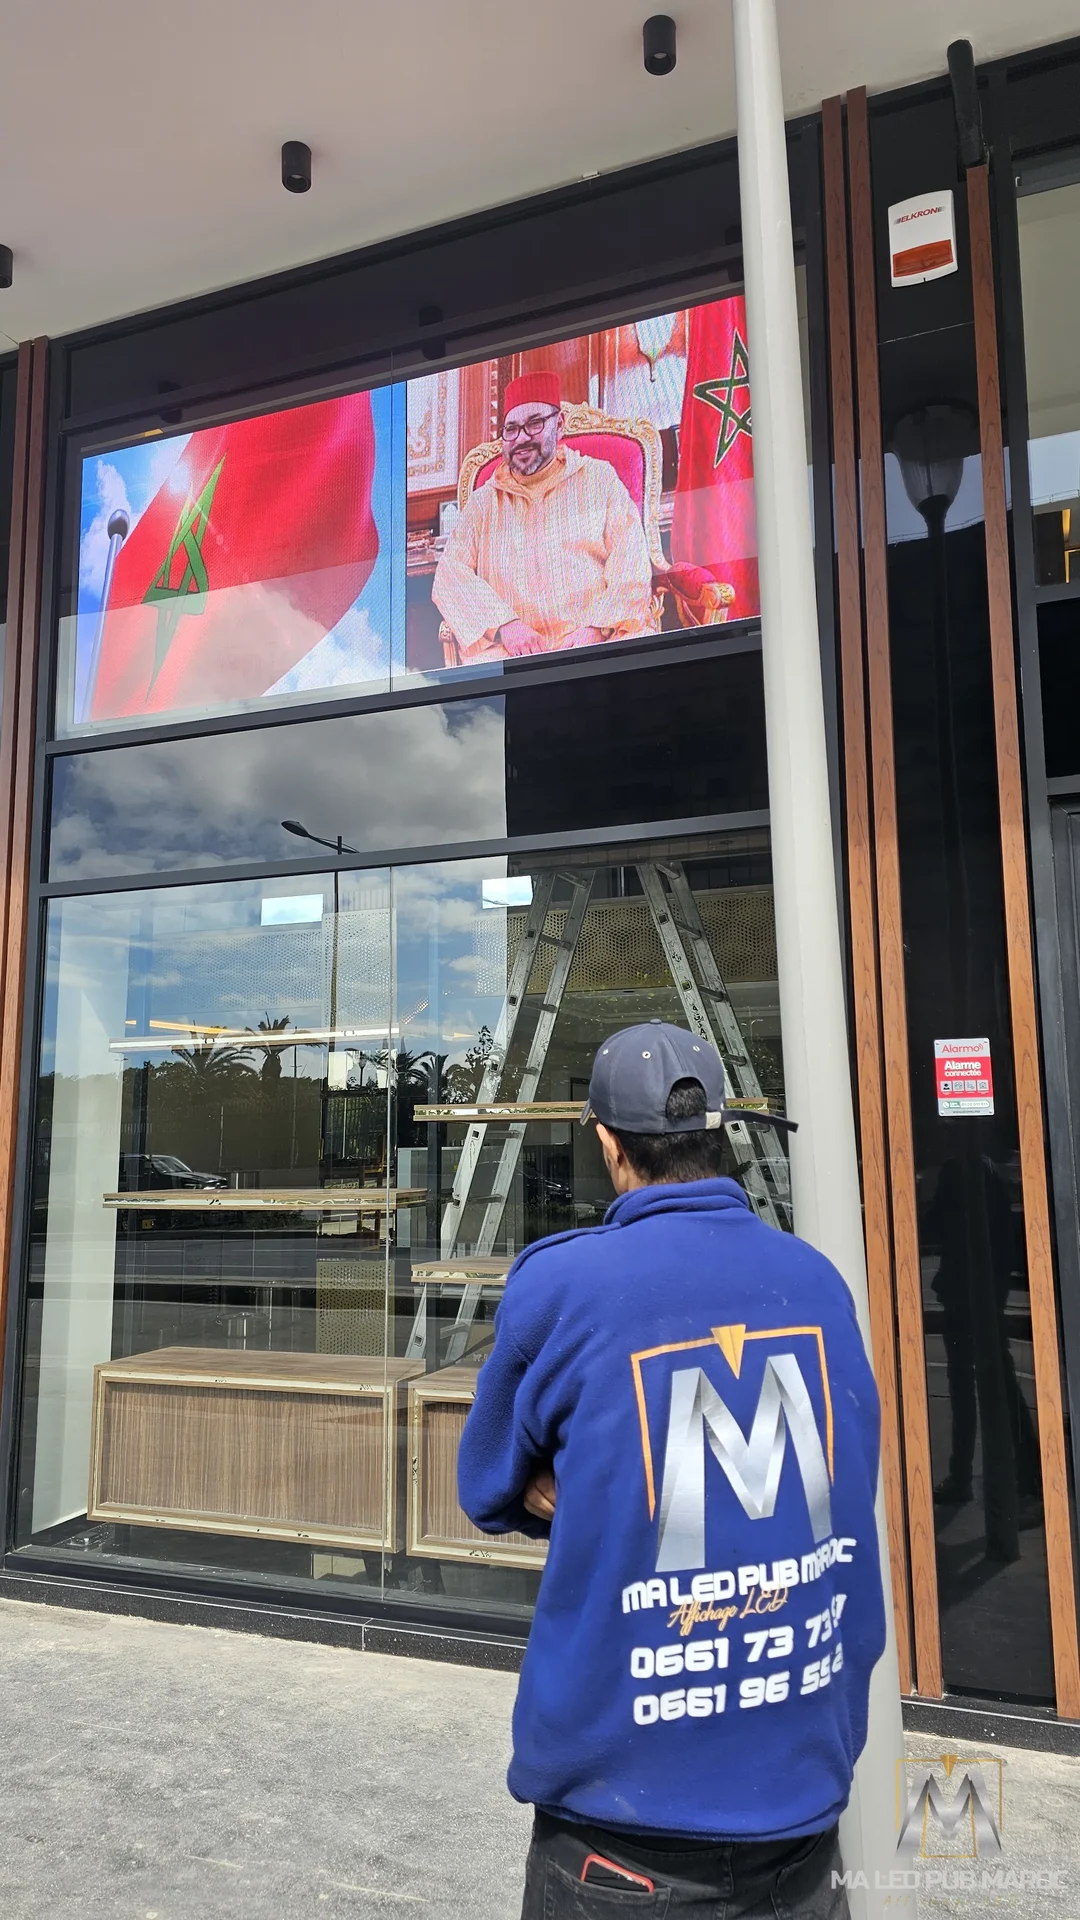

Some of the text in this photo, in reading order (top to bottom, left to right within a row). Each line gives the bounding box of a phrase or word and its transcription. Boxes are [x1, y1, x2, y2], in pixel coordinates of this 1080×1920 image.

[900, 207, 939, 223] ELKRON
[942, 1044, 980, 1053] Alarmo
[944, 1060, 981, 1070] Alarme
[944, 1069, 982, 1077] connectée
[622, 1578, 667, 1614] MA
[670, 1571, 736, 1607] LED
[738, 1558, 800, 1596] PUB
[667, 1599, 738, 1636] Affichage
[630, 1637, 729, 1679] 0661
[743, 1625, 794, 1663] 73
[633, 1684, 727, 1726] 0661
[739, 1671, 790, 1709] 96
